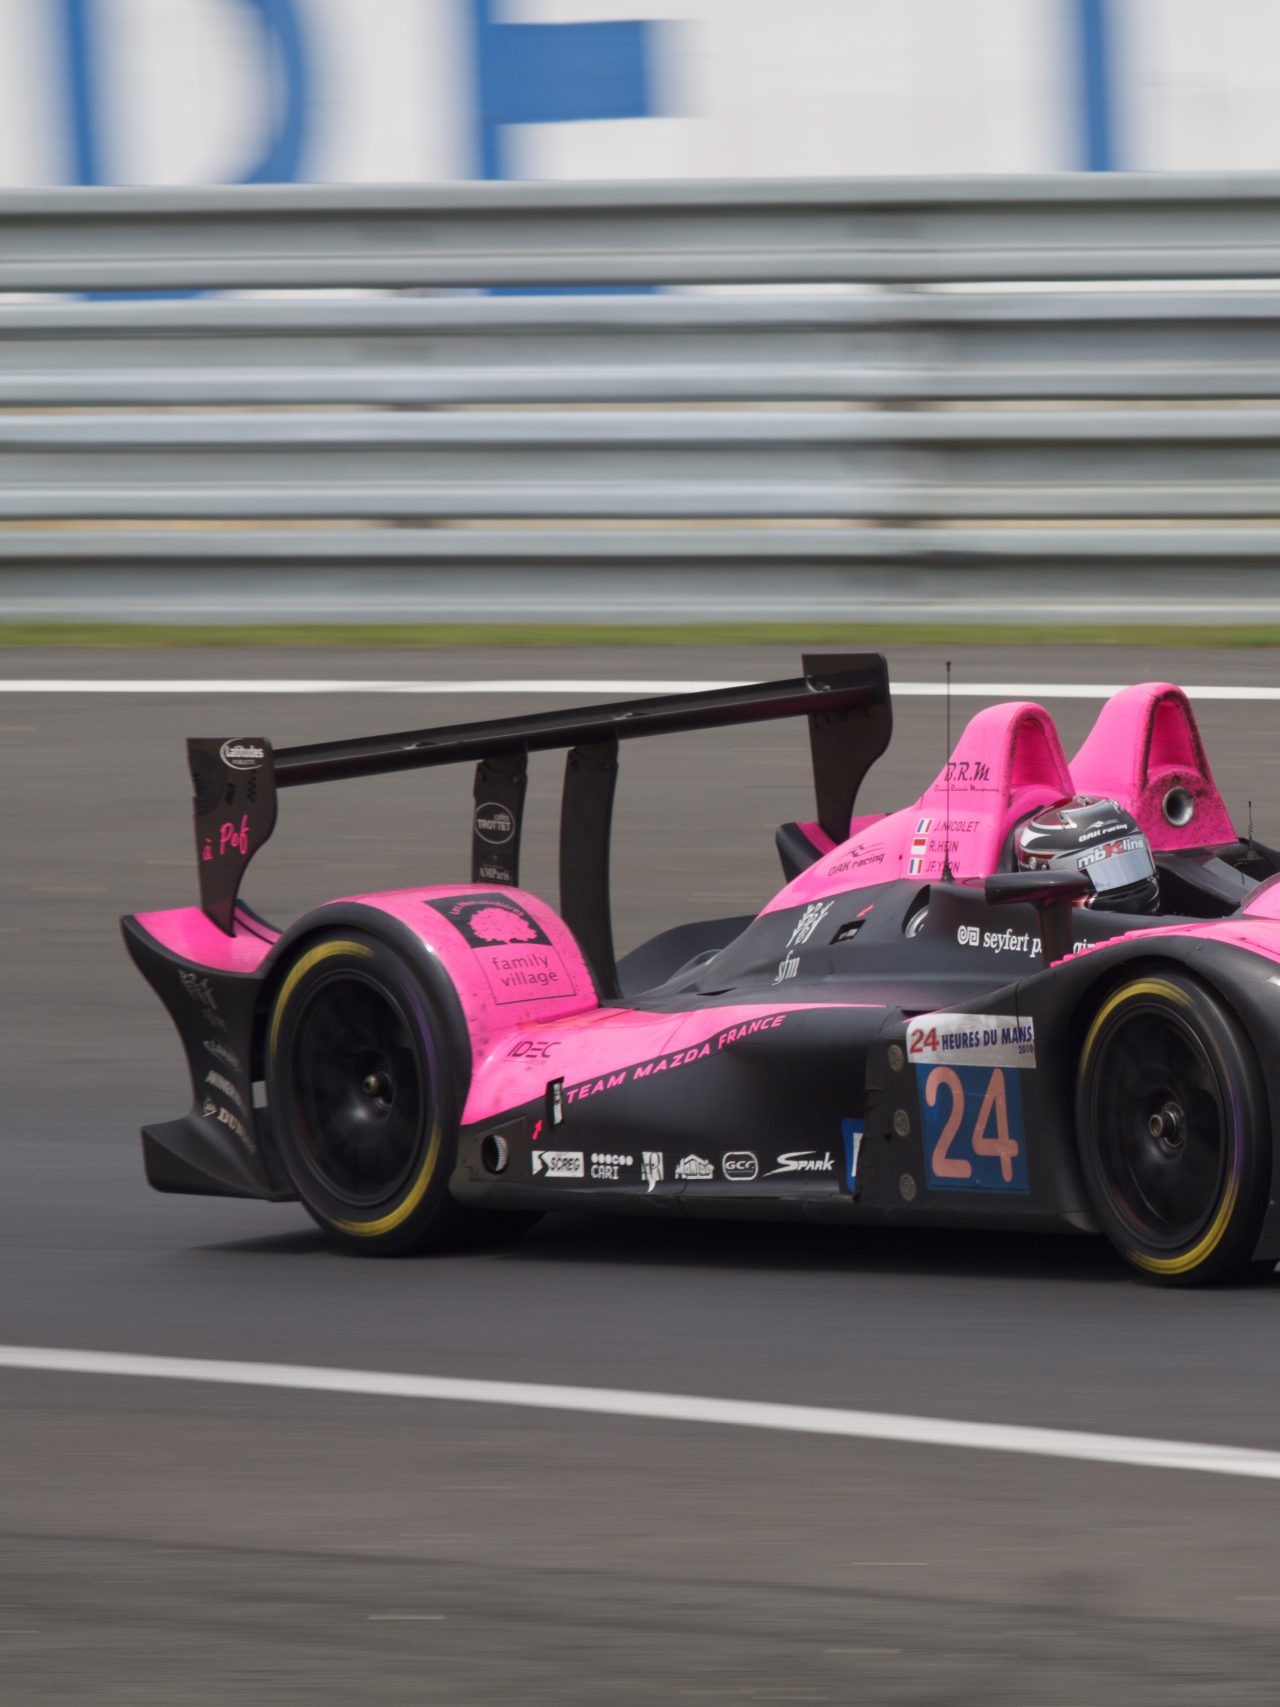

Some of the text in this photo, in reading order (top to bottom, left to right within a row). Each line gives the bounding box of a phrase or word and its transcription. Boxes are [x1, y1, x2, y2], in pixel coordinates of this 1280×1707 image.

[983, 928, 1030, 953] seyfert
[492, 953, 549, 971] family
[500, 971, 559, 987] village
[909, 1025, 1033, 1054] 24 HEURES DU MANS
[566, 1014, 787, 1105] TEAM MAZDA FRANCE
[925, 1066, 1019, 1182] 24
